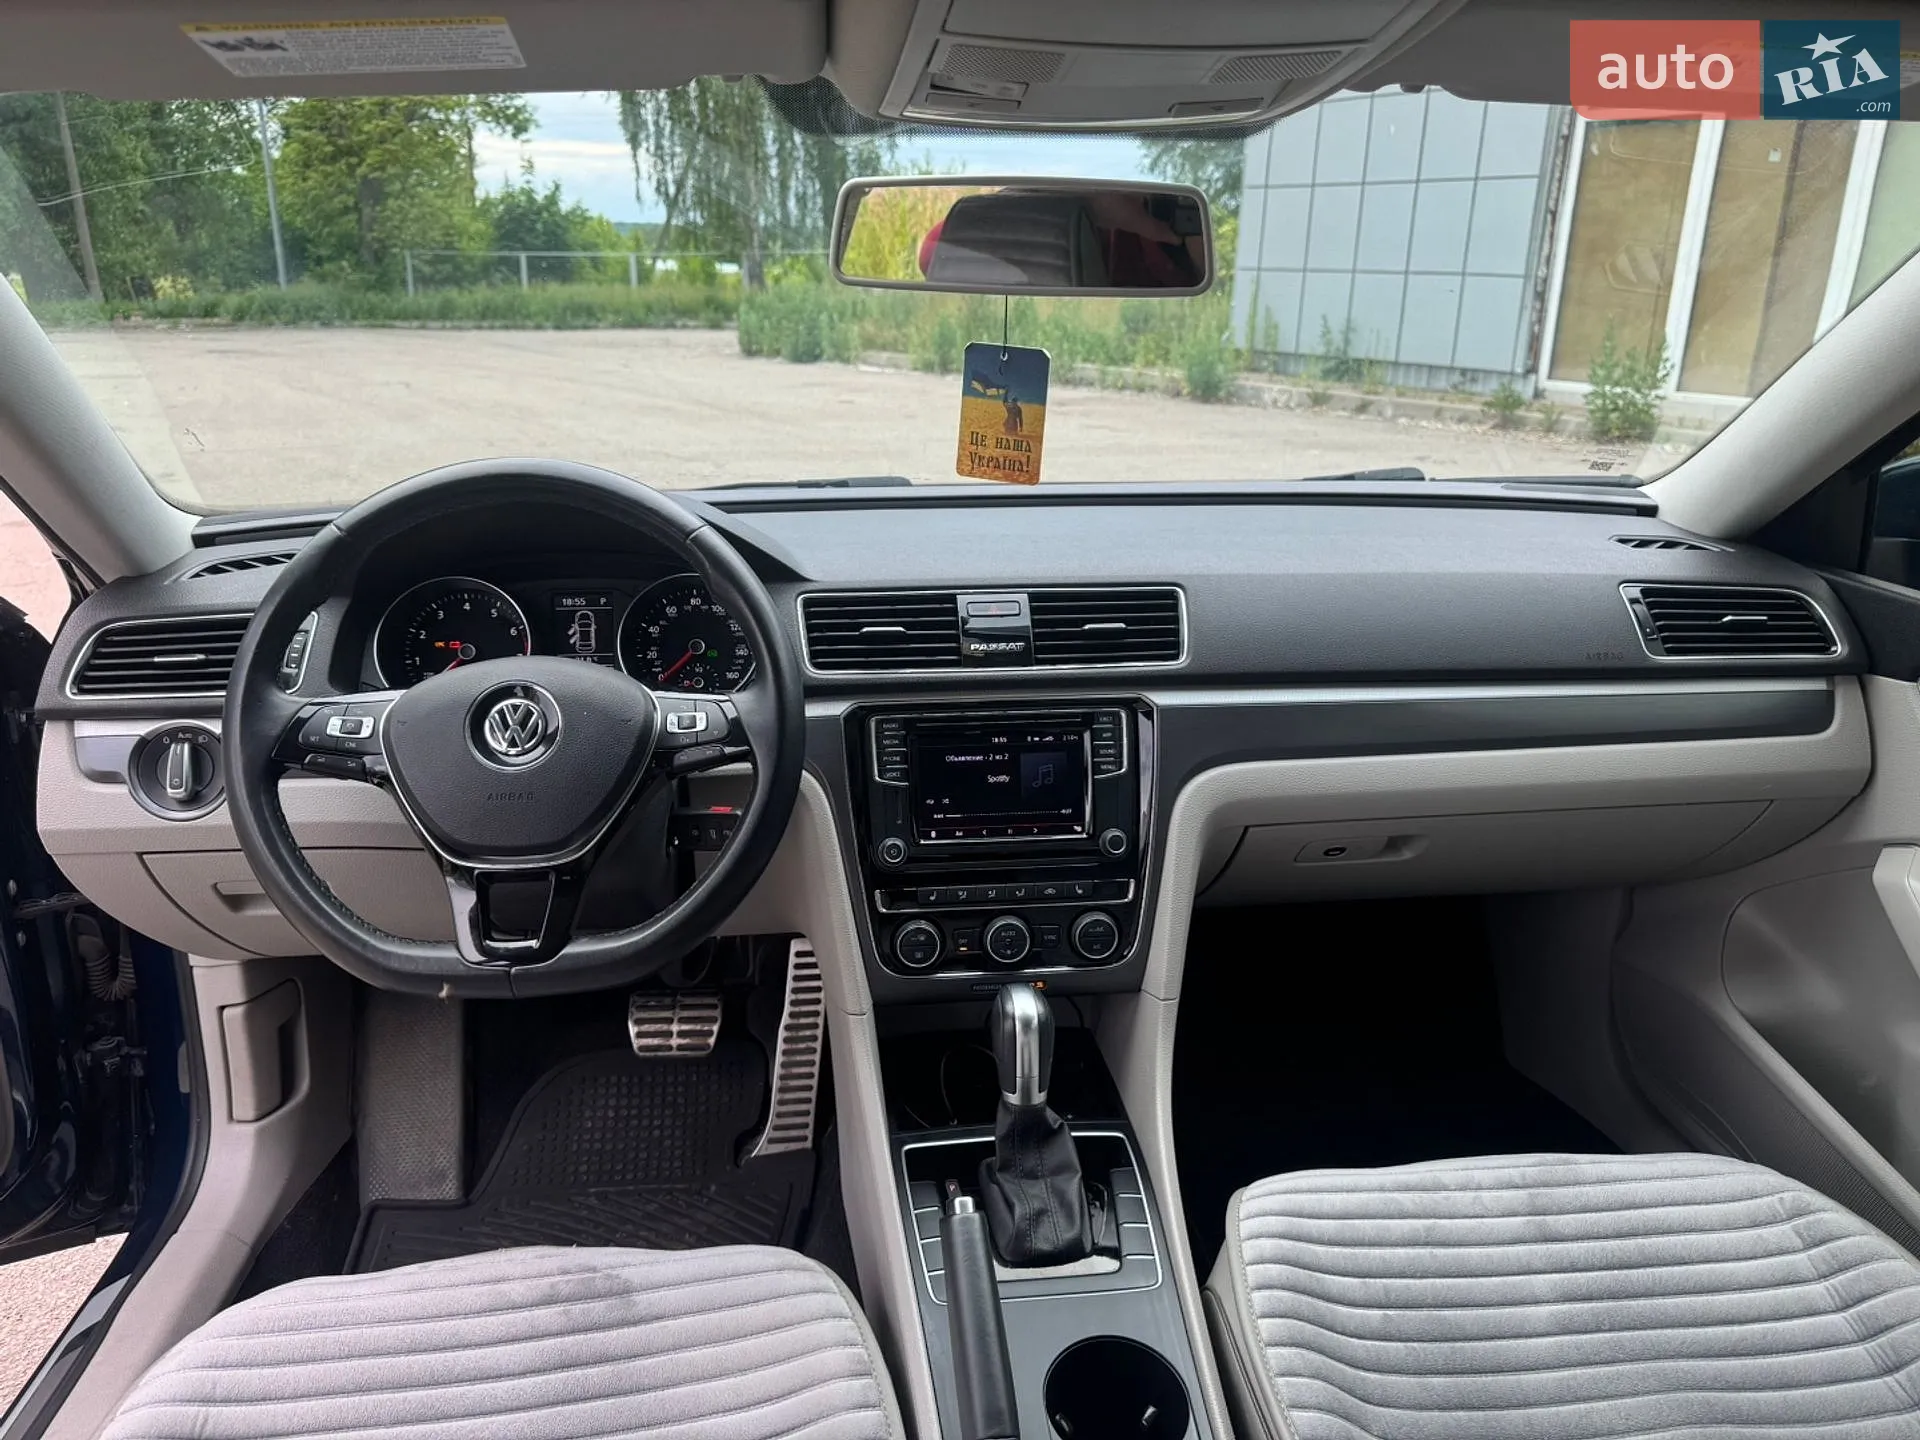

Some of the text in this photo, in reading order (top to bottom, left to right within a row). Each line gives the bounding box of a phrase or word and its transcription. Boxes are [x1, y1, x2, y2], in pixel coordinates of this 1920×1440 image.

[969, 431, 1033, 453] ЦЕ НАША
[968, 451, 1032, 474] УКРАЇНА!
[463, 602, 471, 611] 4
[690, 598, 702, 606] 80
[490, 608, 498, 618] 5
[665, 605, 678, 614] 60
[437, 610, 445, 620] 3
[510, 627, 518, 636] 6
[647, 625, 660, 634] 40
[419, 630, 427, 640] 2
[970, 642, 1025, 652] PASSAT
[646, 650, 658, 659] 20
[414, 656, 421, 666] 1
[987, 774, 1011, 784] Spotify
[487, 791, 536, 801] AIRBAG
